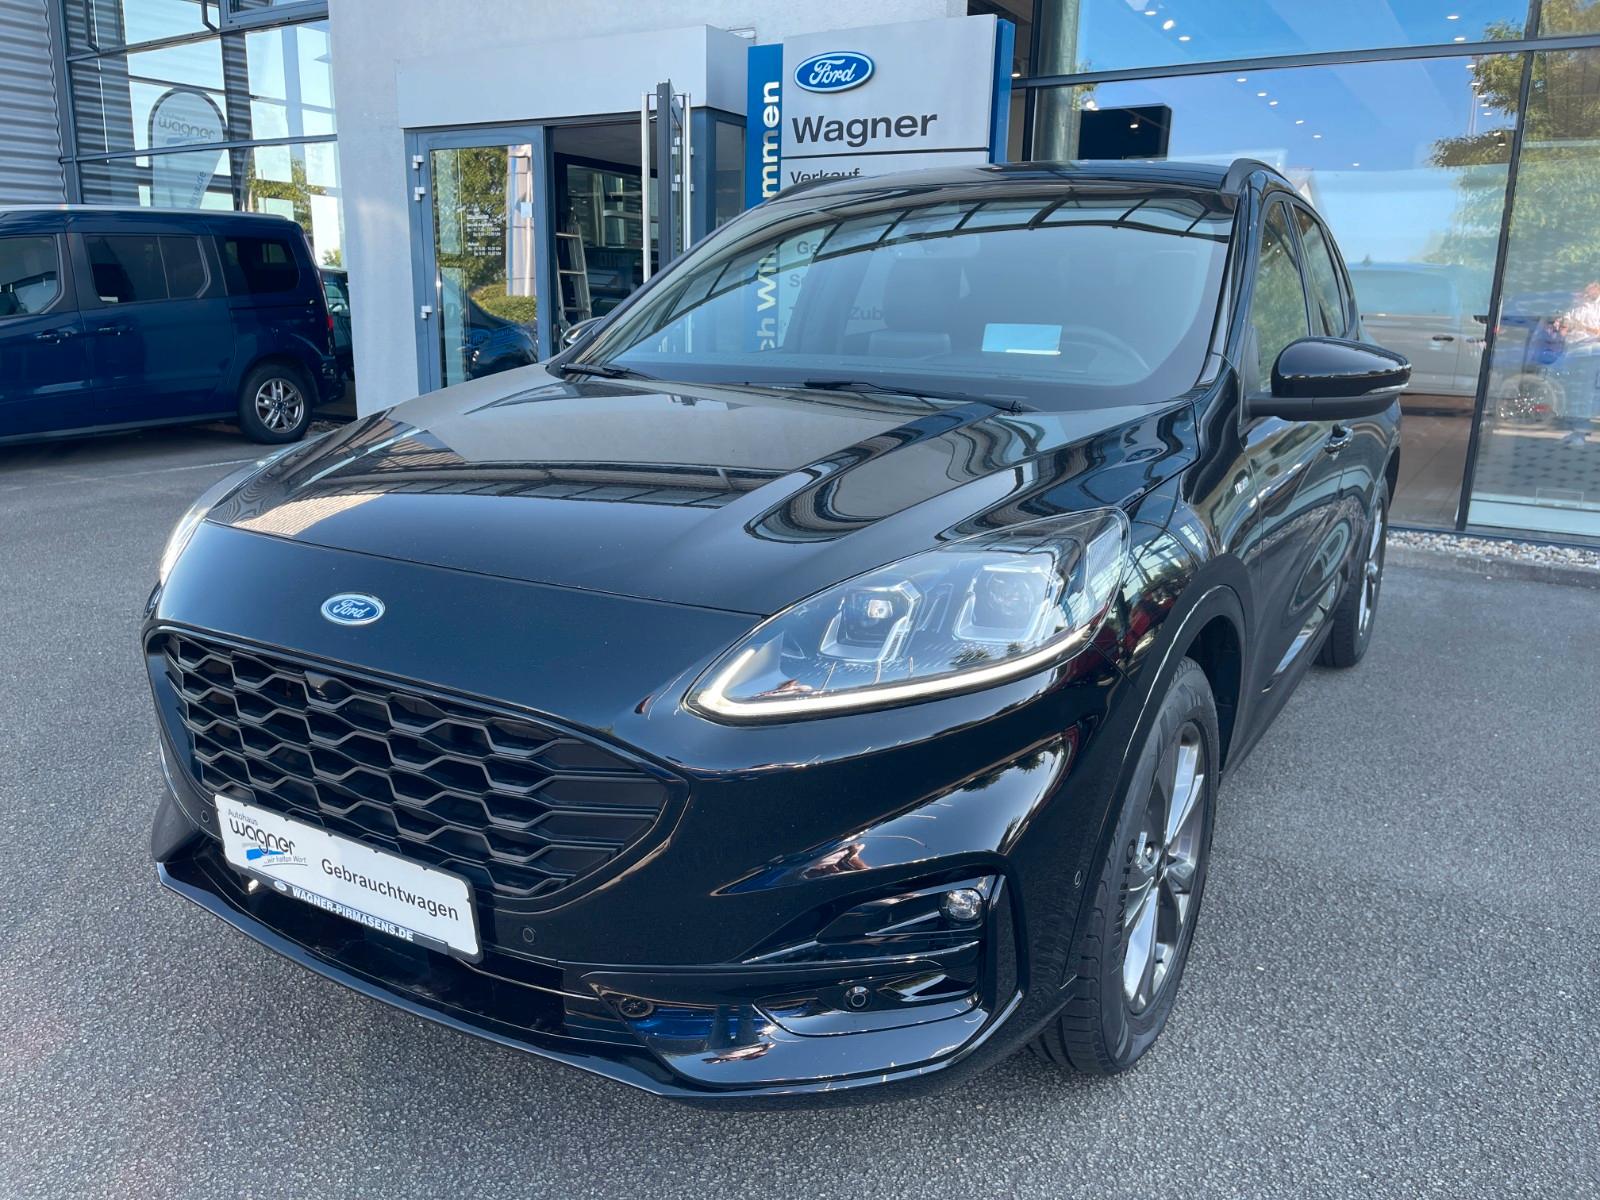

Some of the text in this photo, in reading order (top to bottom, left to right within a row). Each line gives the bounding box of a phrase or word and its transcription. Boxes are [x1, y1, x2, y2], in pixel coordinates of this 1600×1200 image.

[808, 58, 857, 86] Ford
[158, 117, 216, 140] wagner
[791, 113, 938, 148] Wagner
[332, 599, 371, 619] Ford
[229, 817, 296, 856] wagner
[321, 858, 460, 921] Gebrauchtwagen
[291, 885, 415, 942] WAGNER-PIRMASENS.DE
